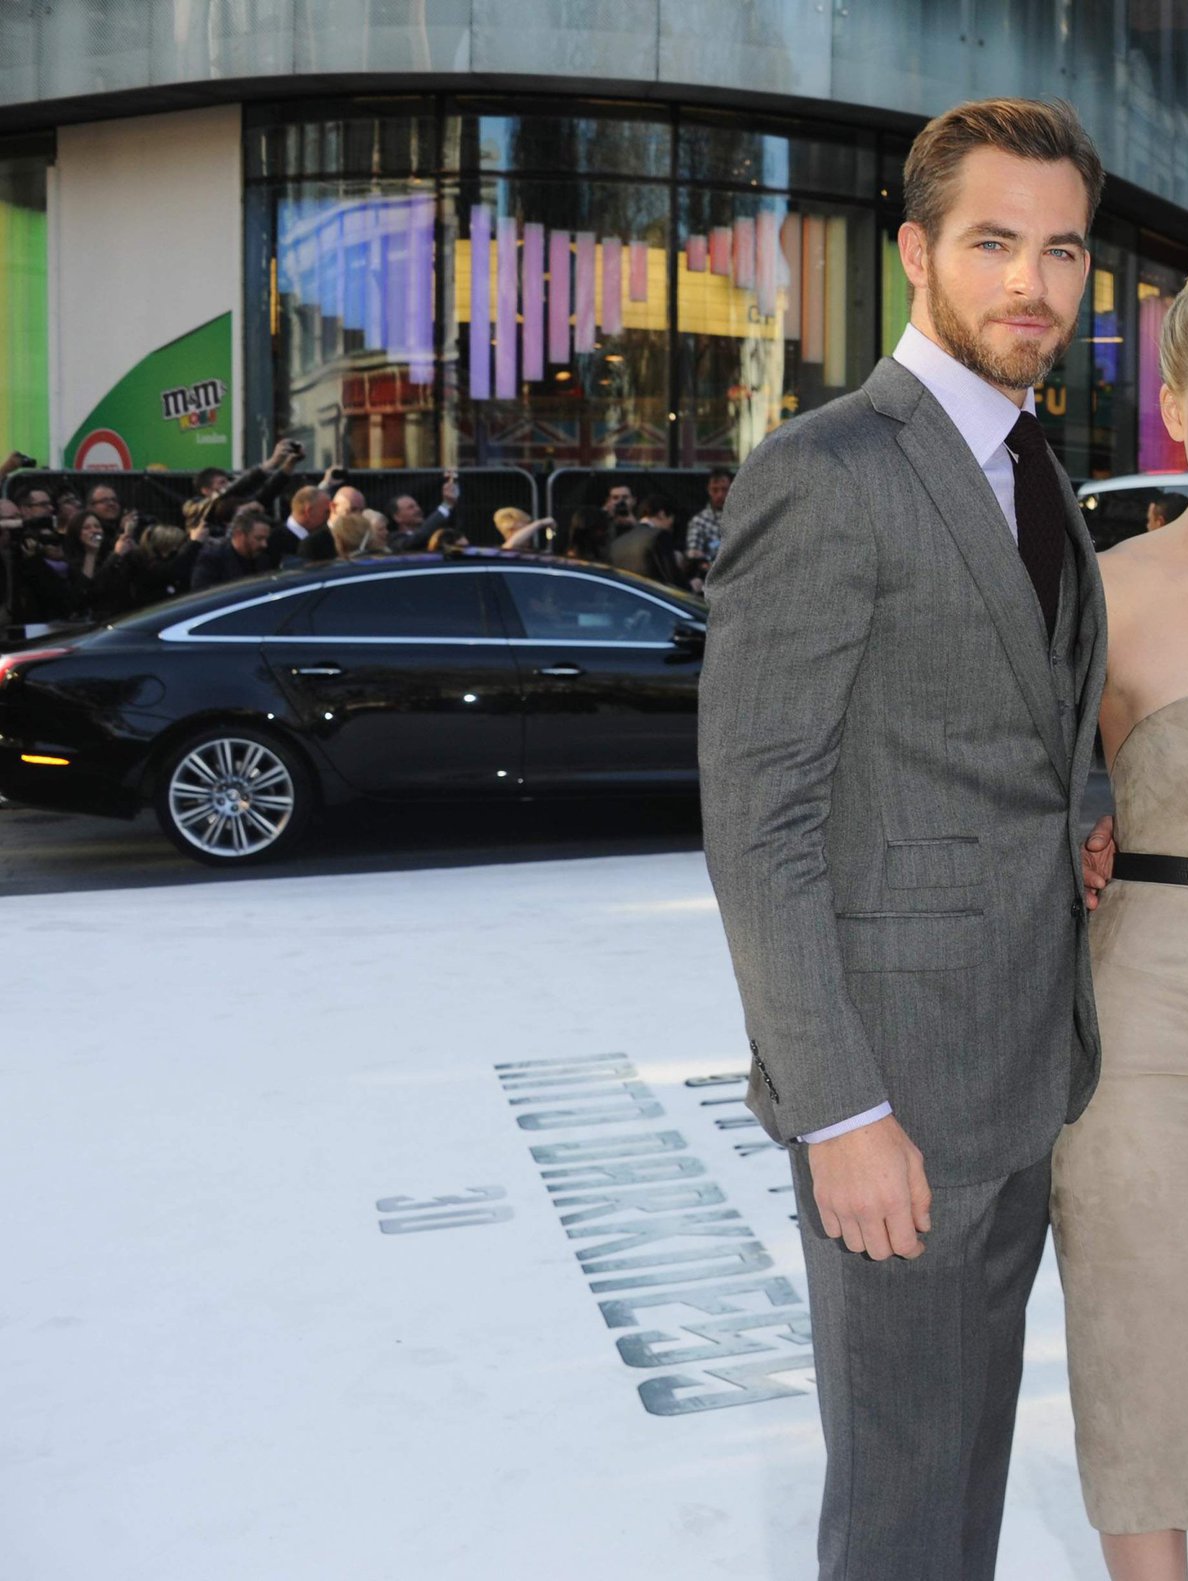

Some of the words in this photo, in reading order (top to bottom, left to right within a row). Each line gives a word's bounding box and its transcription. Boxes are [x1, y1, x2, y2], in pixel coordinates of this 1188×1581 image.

[494, 1052, 666, 1131] INTO
[375, 1185, 514, 1234] 3D
[528, 1129, 818, 1416] DARKNESS
